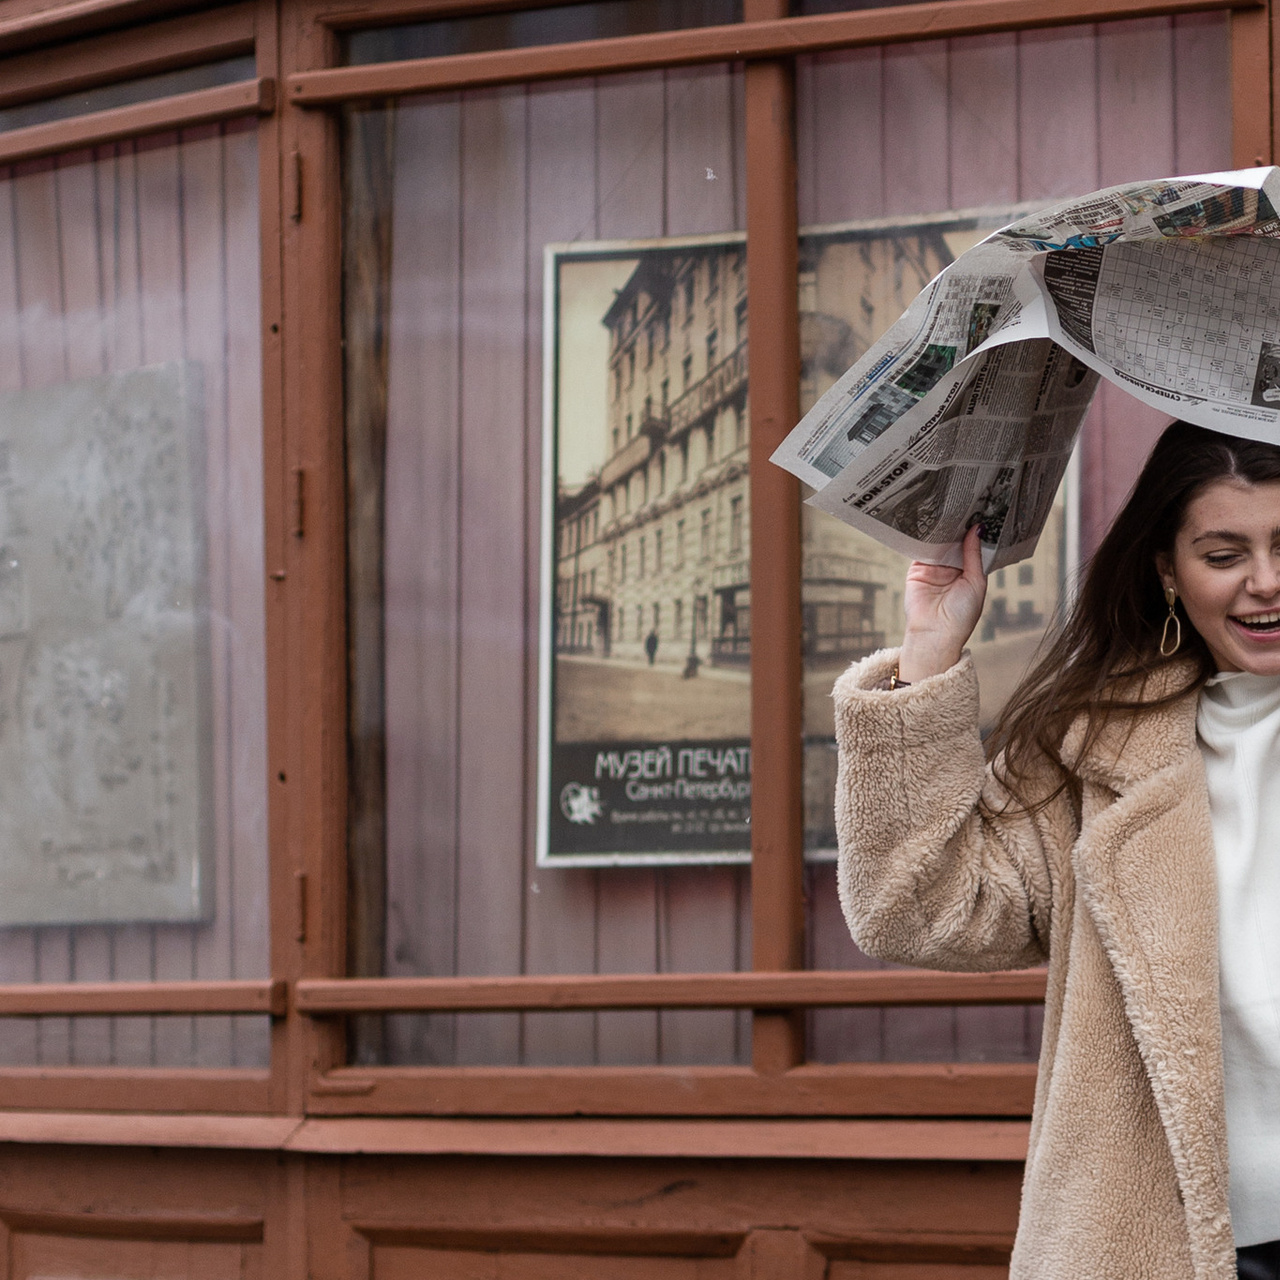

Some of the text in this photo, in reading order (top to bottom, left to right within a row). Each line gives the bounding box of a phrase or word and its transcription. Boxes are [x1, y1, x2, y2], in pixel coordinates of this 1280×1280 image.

[920, 404, 946, 433] ОСТРЫЙ
[853, 461, 910, 509] NON-STOP
[594, 746, 752, 780] МУЗЕЙ ПЕЧАТ
[624, 777, 752, 802] Санкт-Петербур
